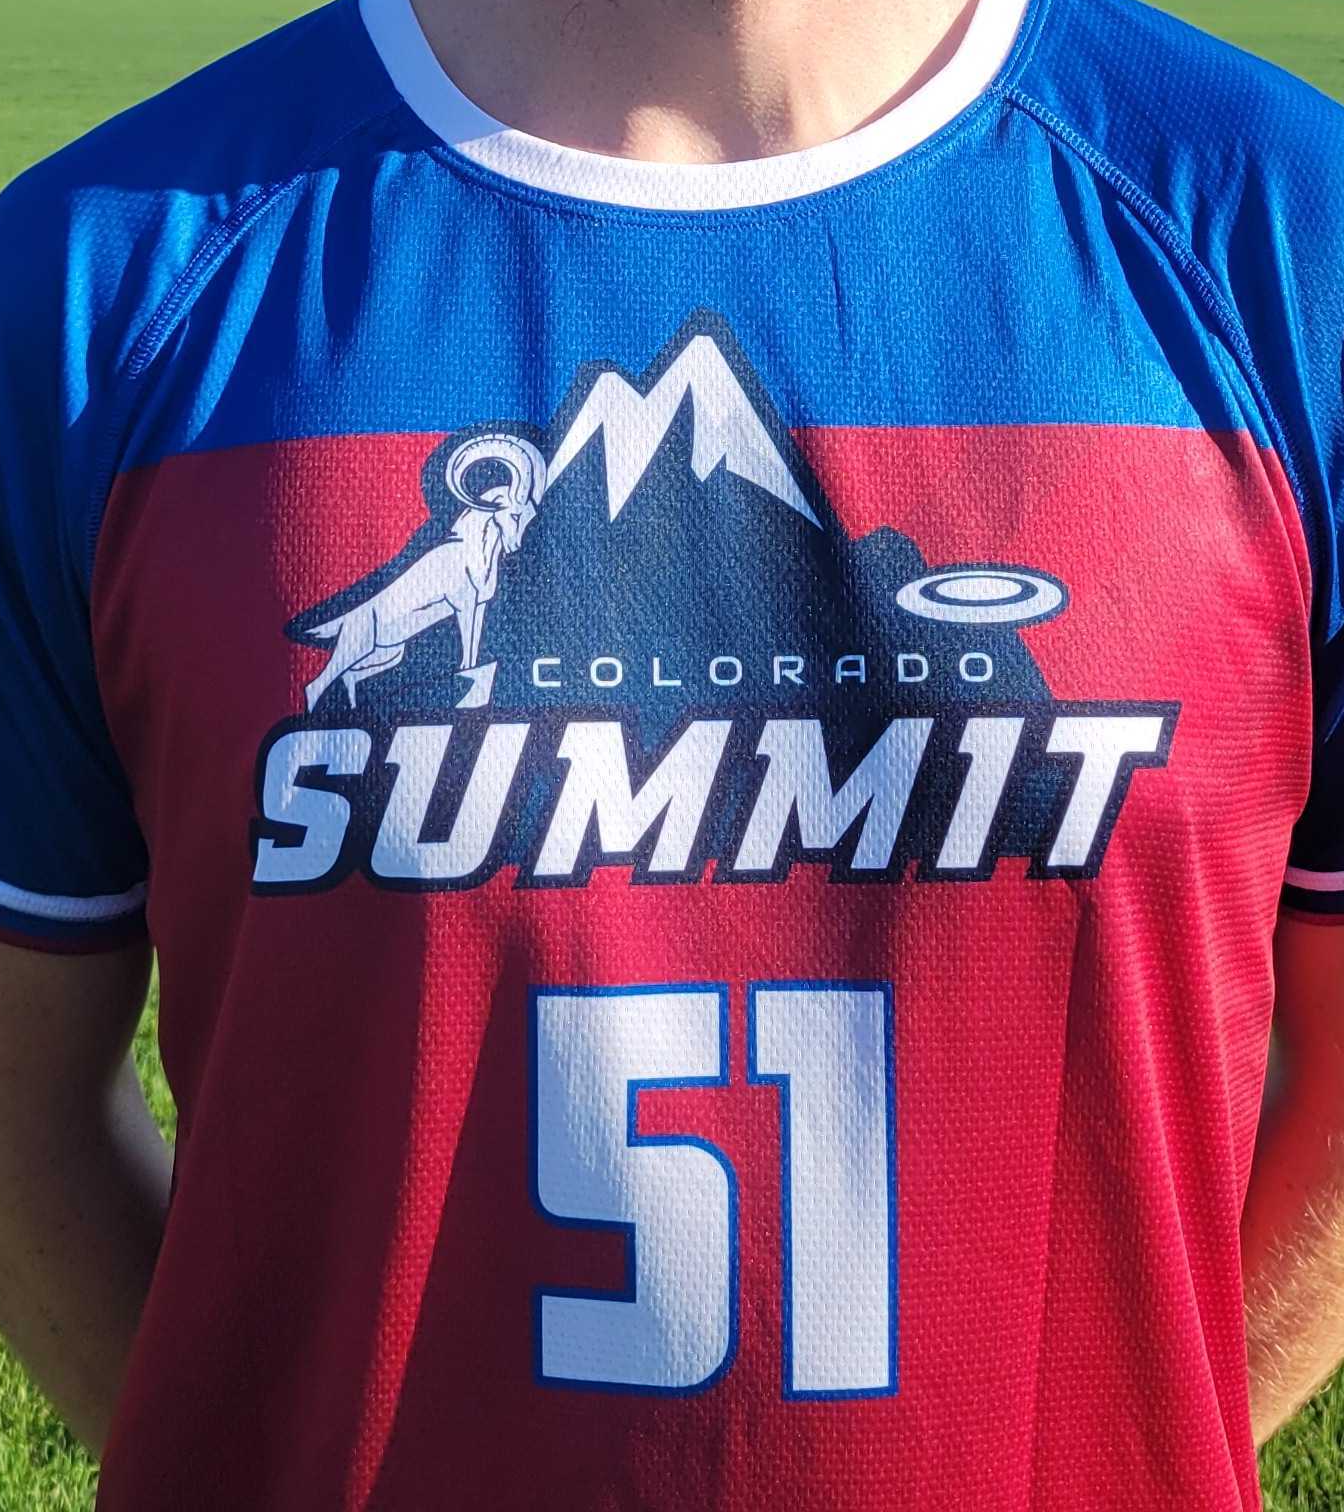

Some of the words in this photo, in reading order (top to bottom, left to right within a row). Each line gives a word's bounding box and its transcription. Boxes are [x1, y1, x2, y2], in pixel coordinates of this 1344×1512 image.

[531, 651, 994, 688] COLORADO
[253, 715, 1165, 884] SUMMIT
[532, 984, 895, 1397] 51
